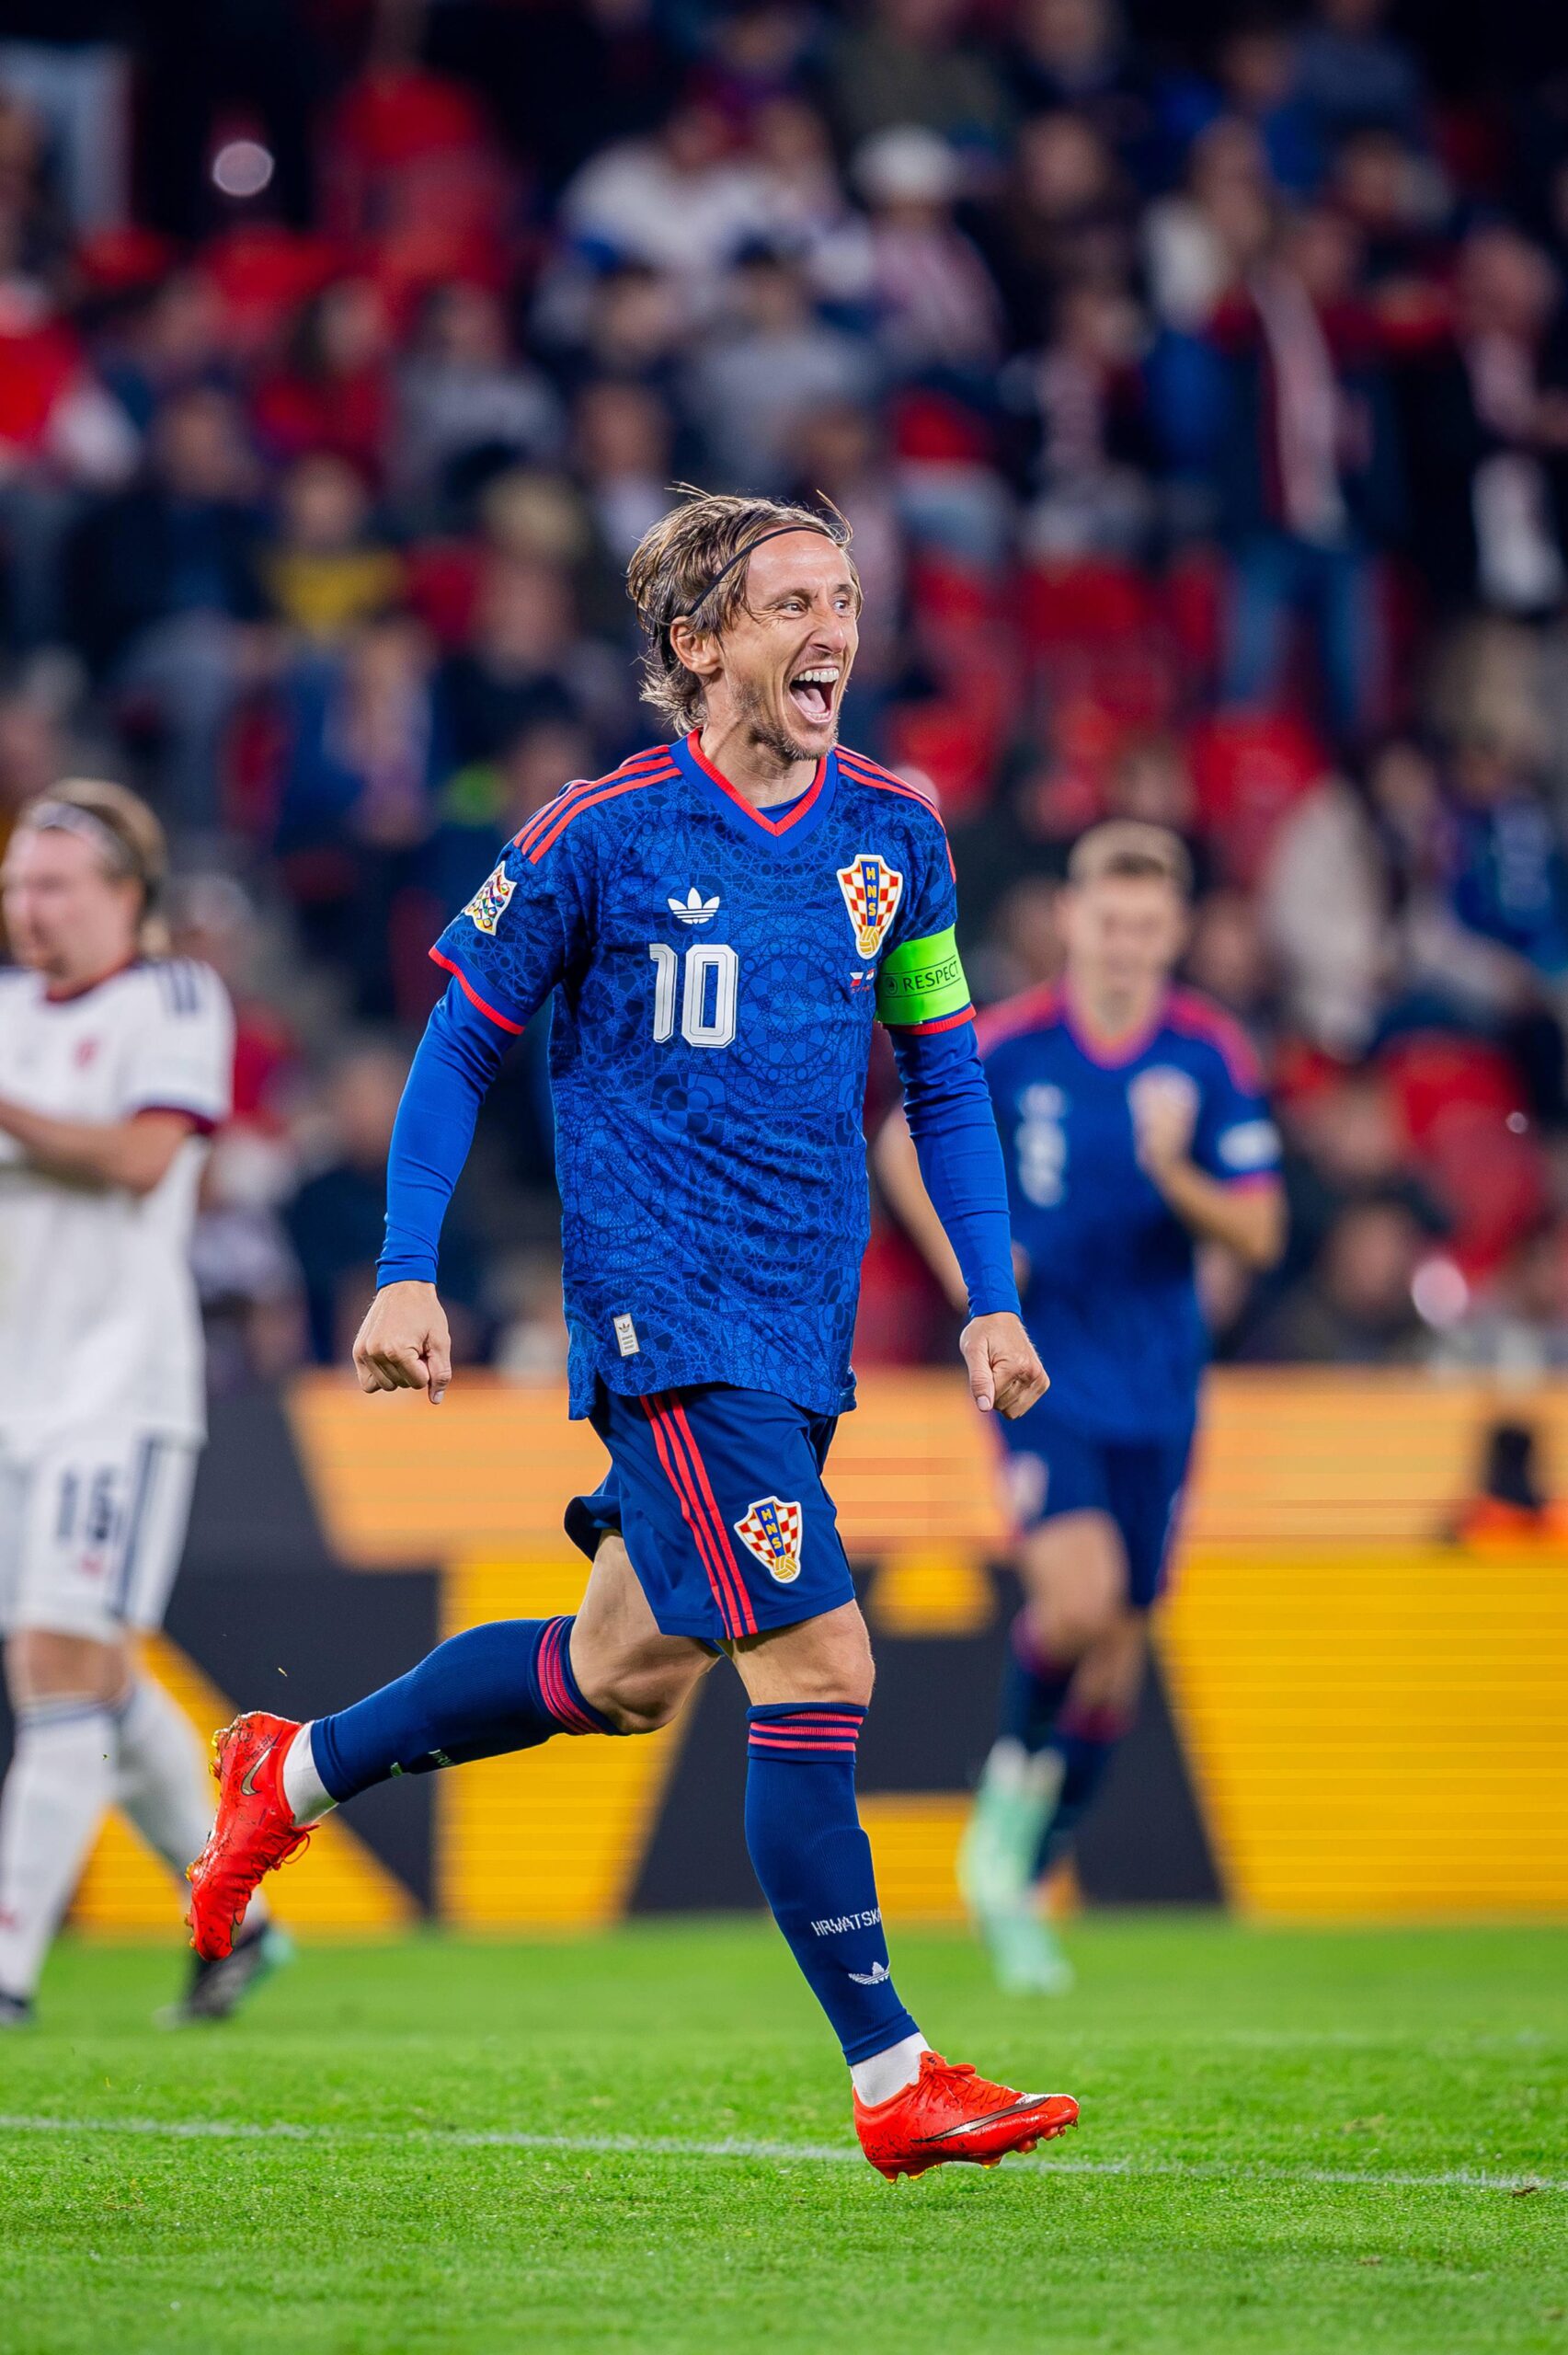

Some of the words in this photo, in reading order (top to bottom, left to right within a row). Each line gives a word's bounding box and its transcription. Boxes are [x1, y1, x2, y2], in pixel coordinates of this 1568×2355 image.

[865, 867, 877, 917] HNS
[649, 943, 738, 1049] 10
[902, 960, 959, 992] RESPECT
[761, 1508, 782, 1549] HNS
